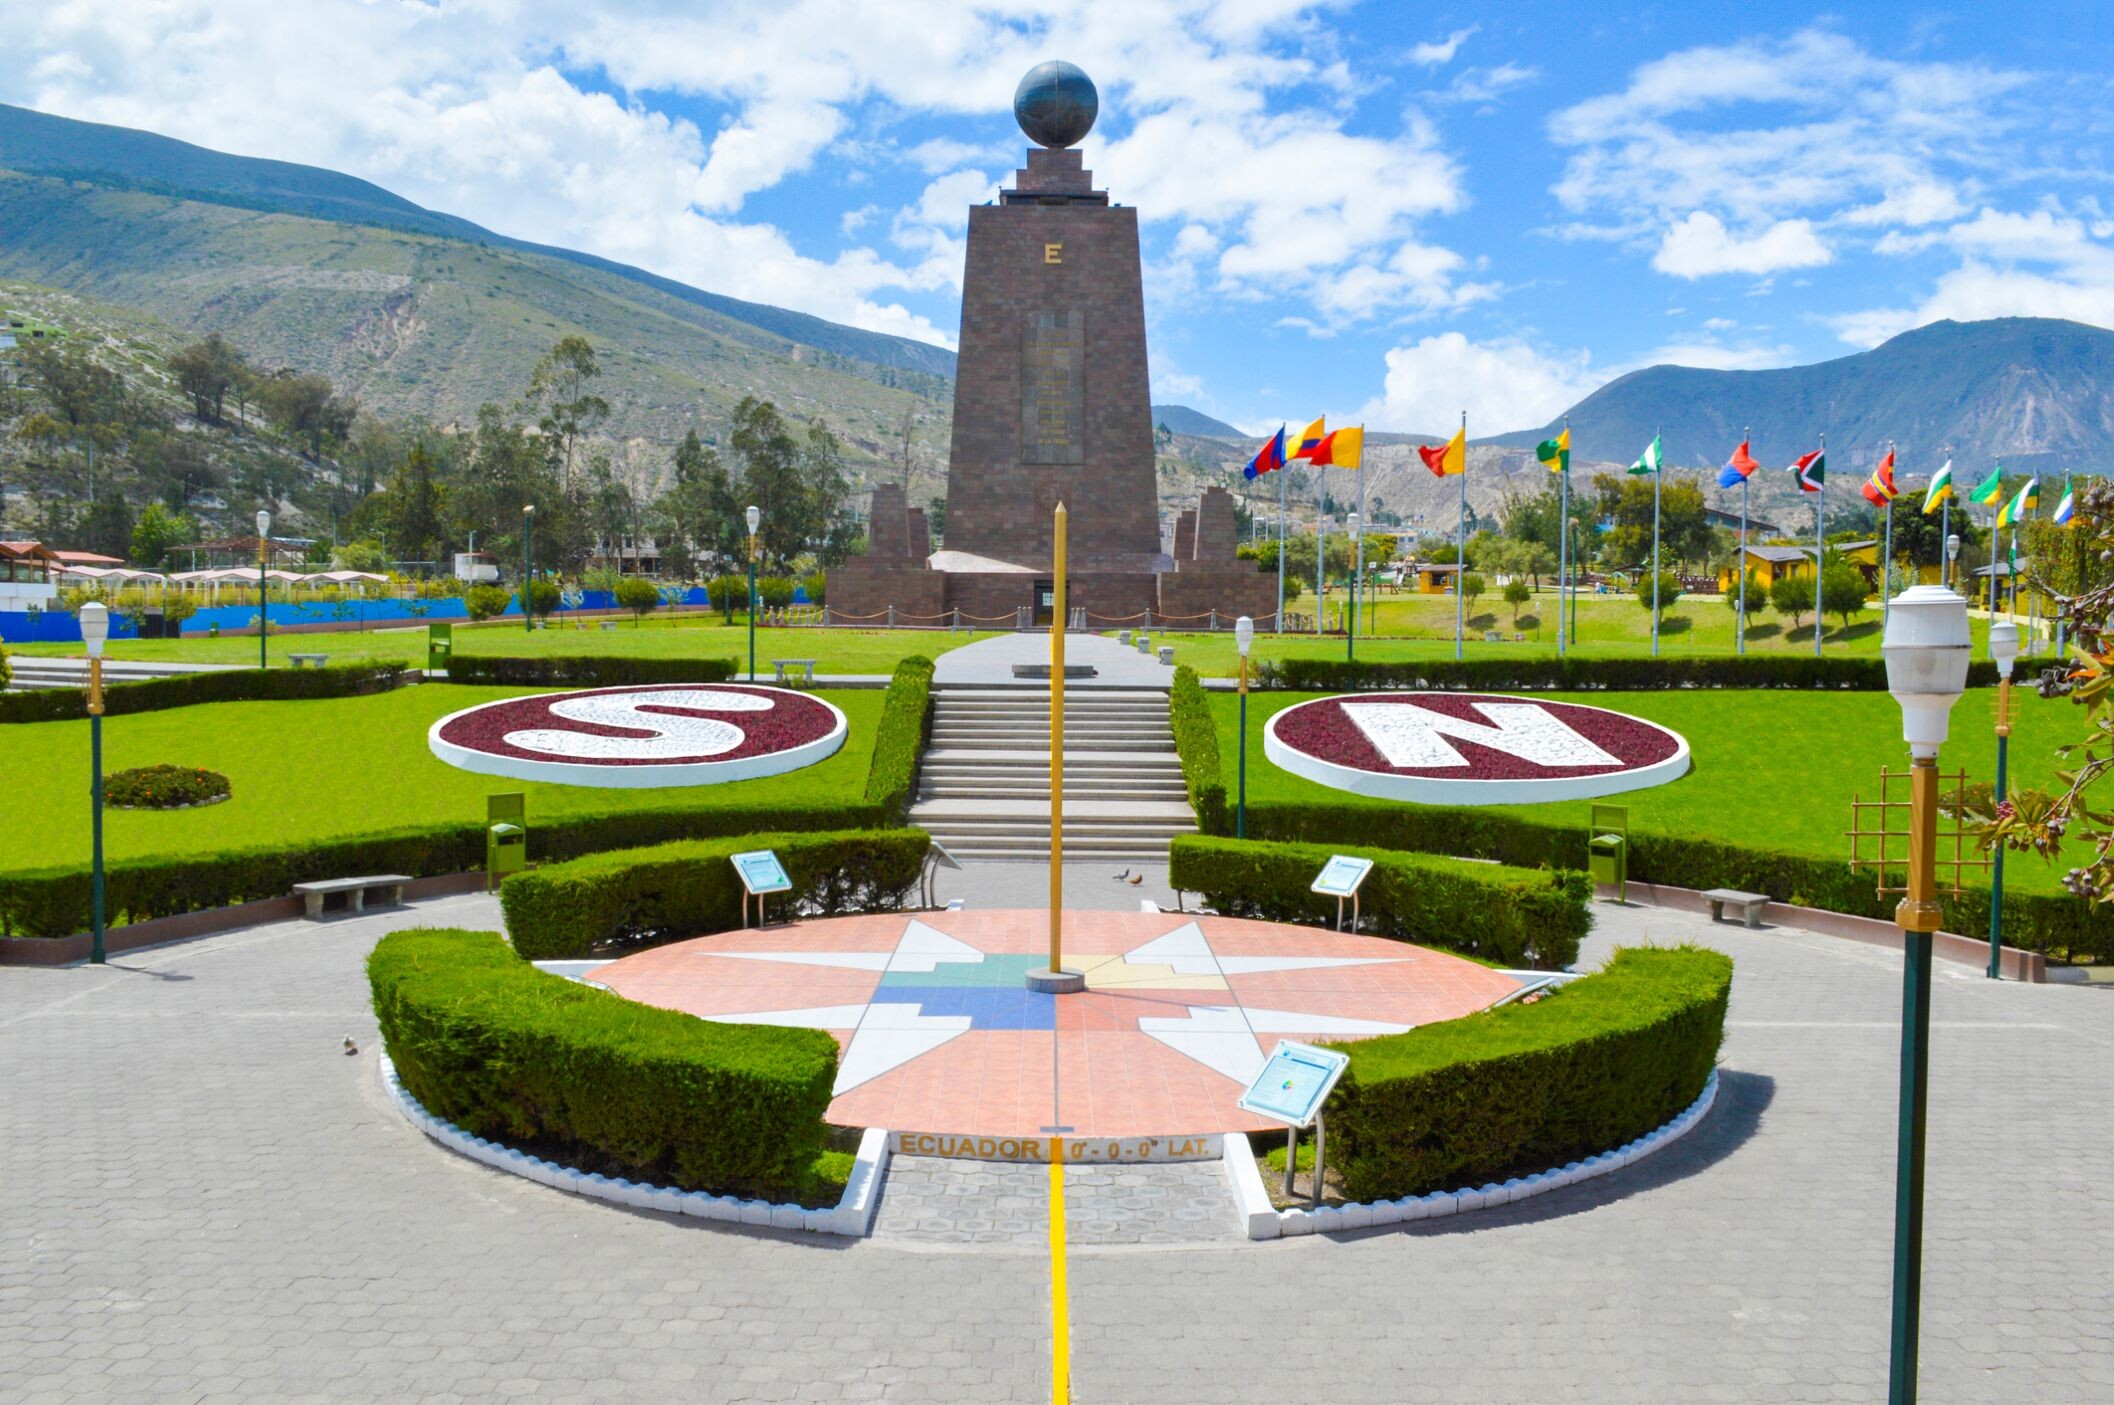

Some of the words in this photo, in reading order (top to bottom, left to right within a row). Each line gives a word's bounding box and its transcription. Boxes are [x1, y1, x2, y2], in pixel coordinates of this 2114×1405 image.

[1045, 244, 1062, 264] E
[502, 690, 775, 758] S
[1340, 702, 1625, 767] N
[900, 1134, 1041, 1159] ECUADOR
[1168, 1138, 1209, 1157] LAT.
